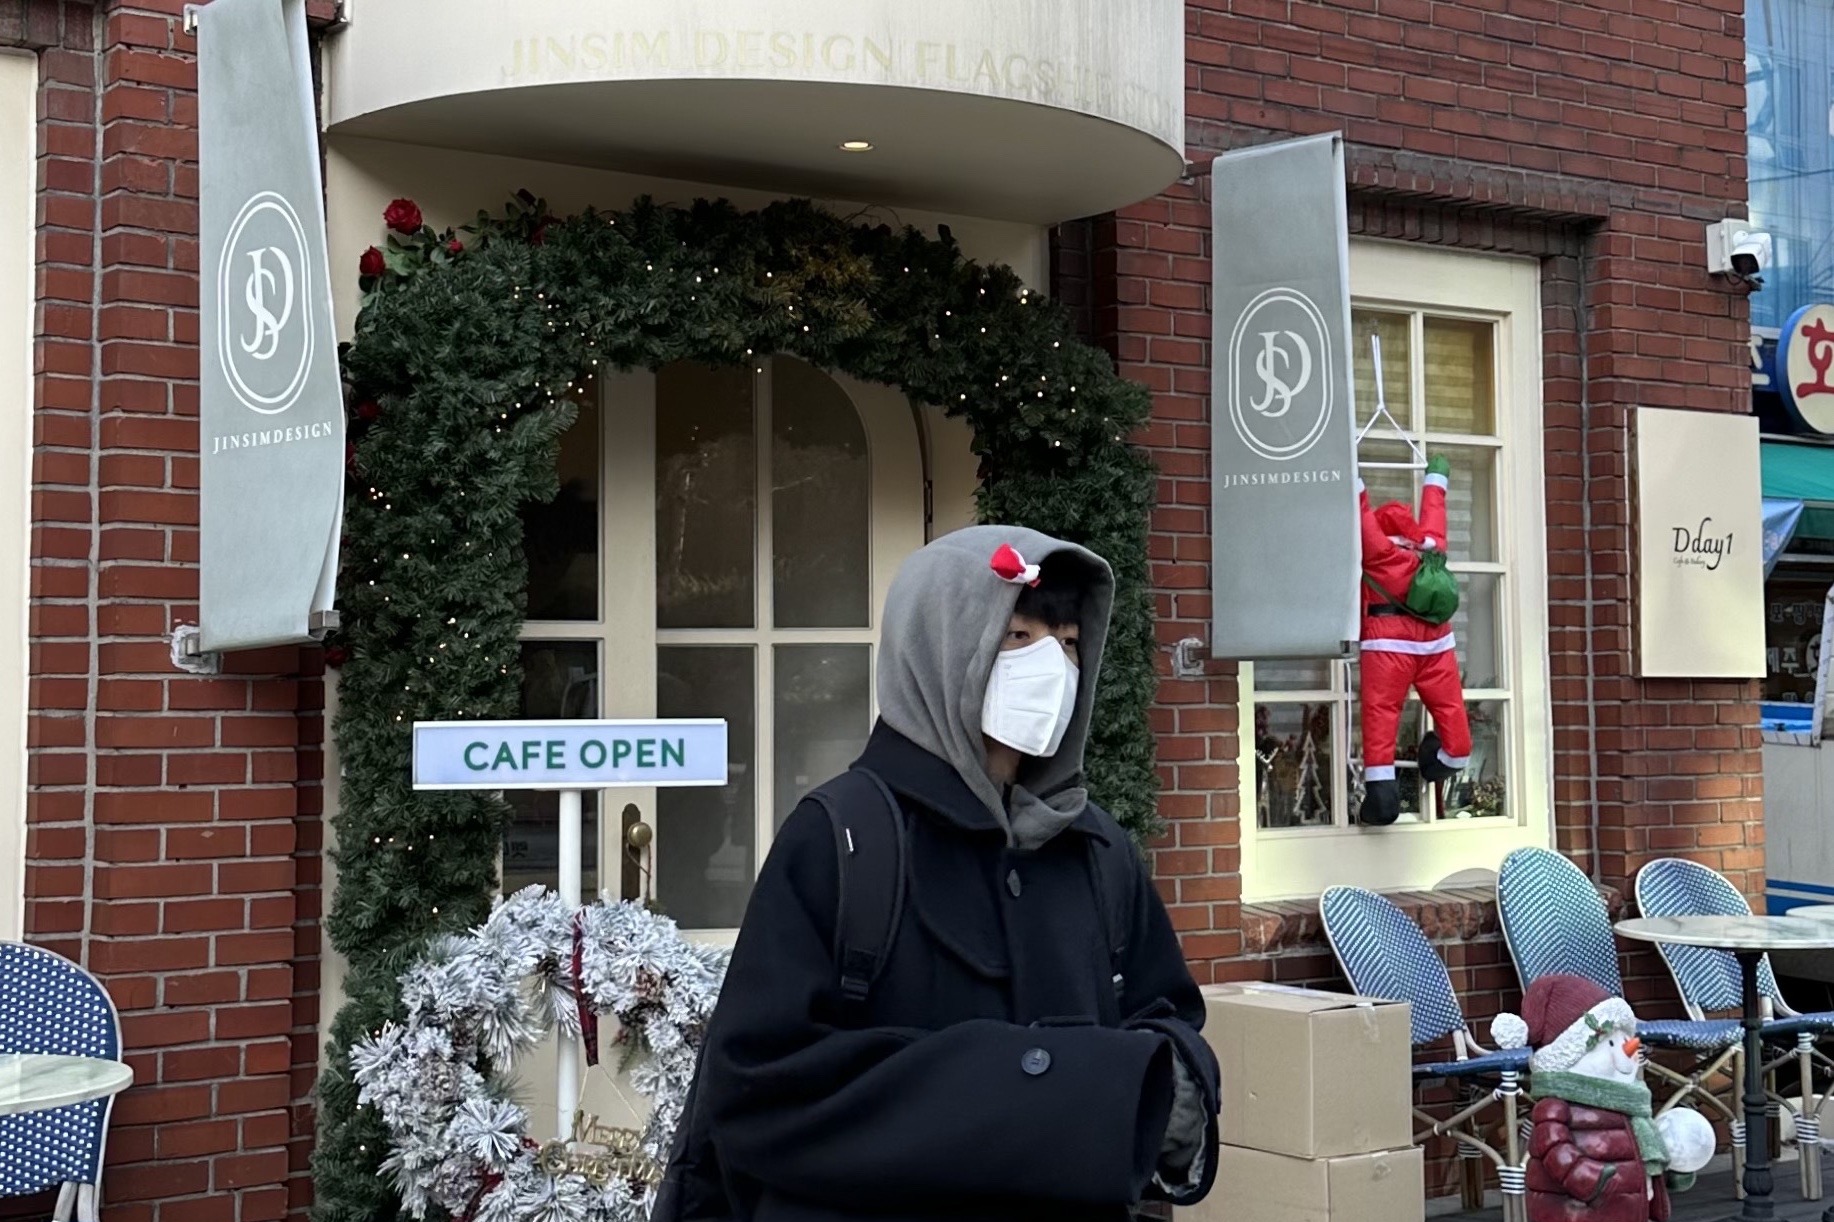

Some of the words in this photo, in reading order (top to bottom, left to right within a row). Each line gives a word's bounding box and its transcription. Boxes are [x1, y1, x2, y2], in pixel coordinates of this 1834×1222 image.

[501, 31, 670, 77] JINSIM
[694, 30, 893, 74] DESIGN
[212, 421, 332, 455] JINSIMDESIGN
[1223, 470, 1341, 488] JINSIMDESIGN
[463, 740, 566, 771] CAFE
[579, 738, 685, 769] OPEN
